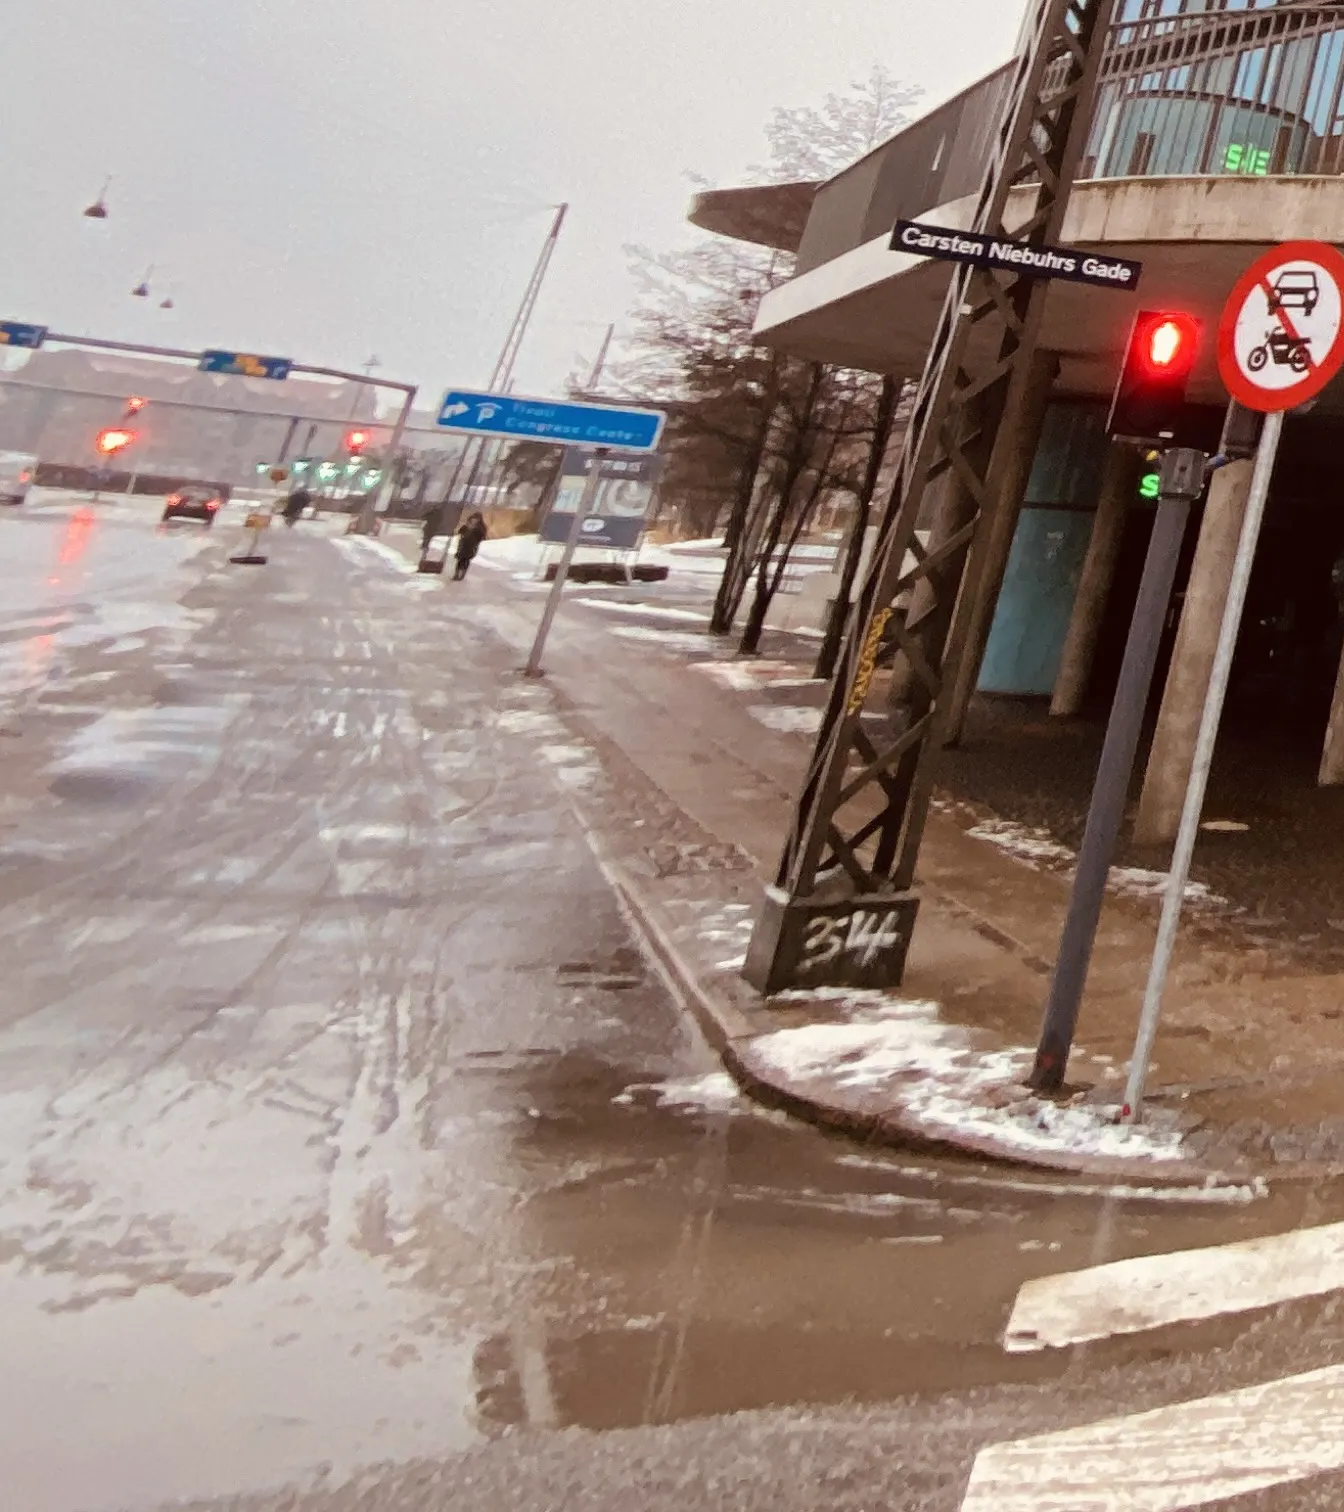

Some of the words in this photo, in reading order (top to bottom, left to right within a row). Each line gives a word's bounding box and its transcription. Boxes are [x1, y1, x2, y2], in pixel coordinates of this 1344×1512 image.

[901, 226, 984, 256] Carsten
[988, 241, 1076, 273] Niebuhrs
[1082, 258, 1132, 282] Gade
